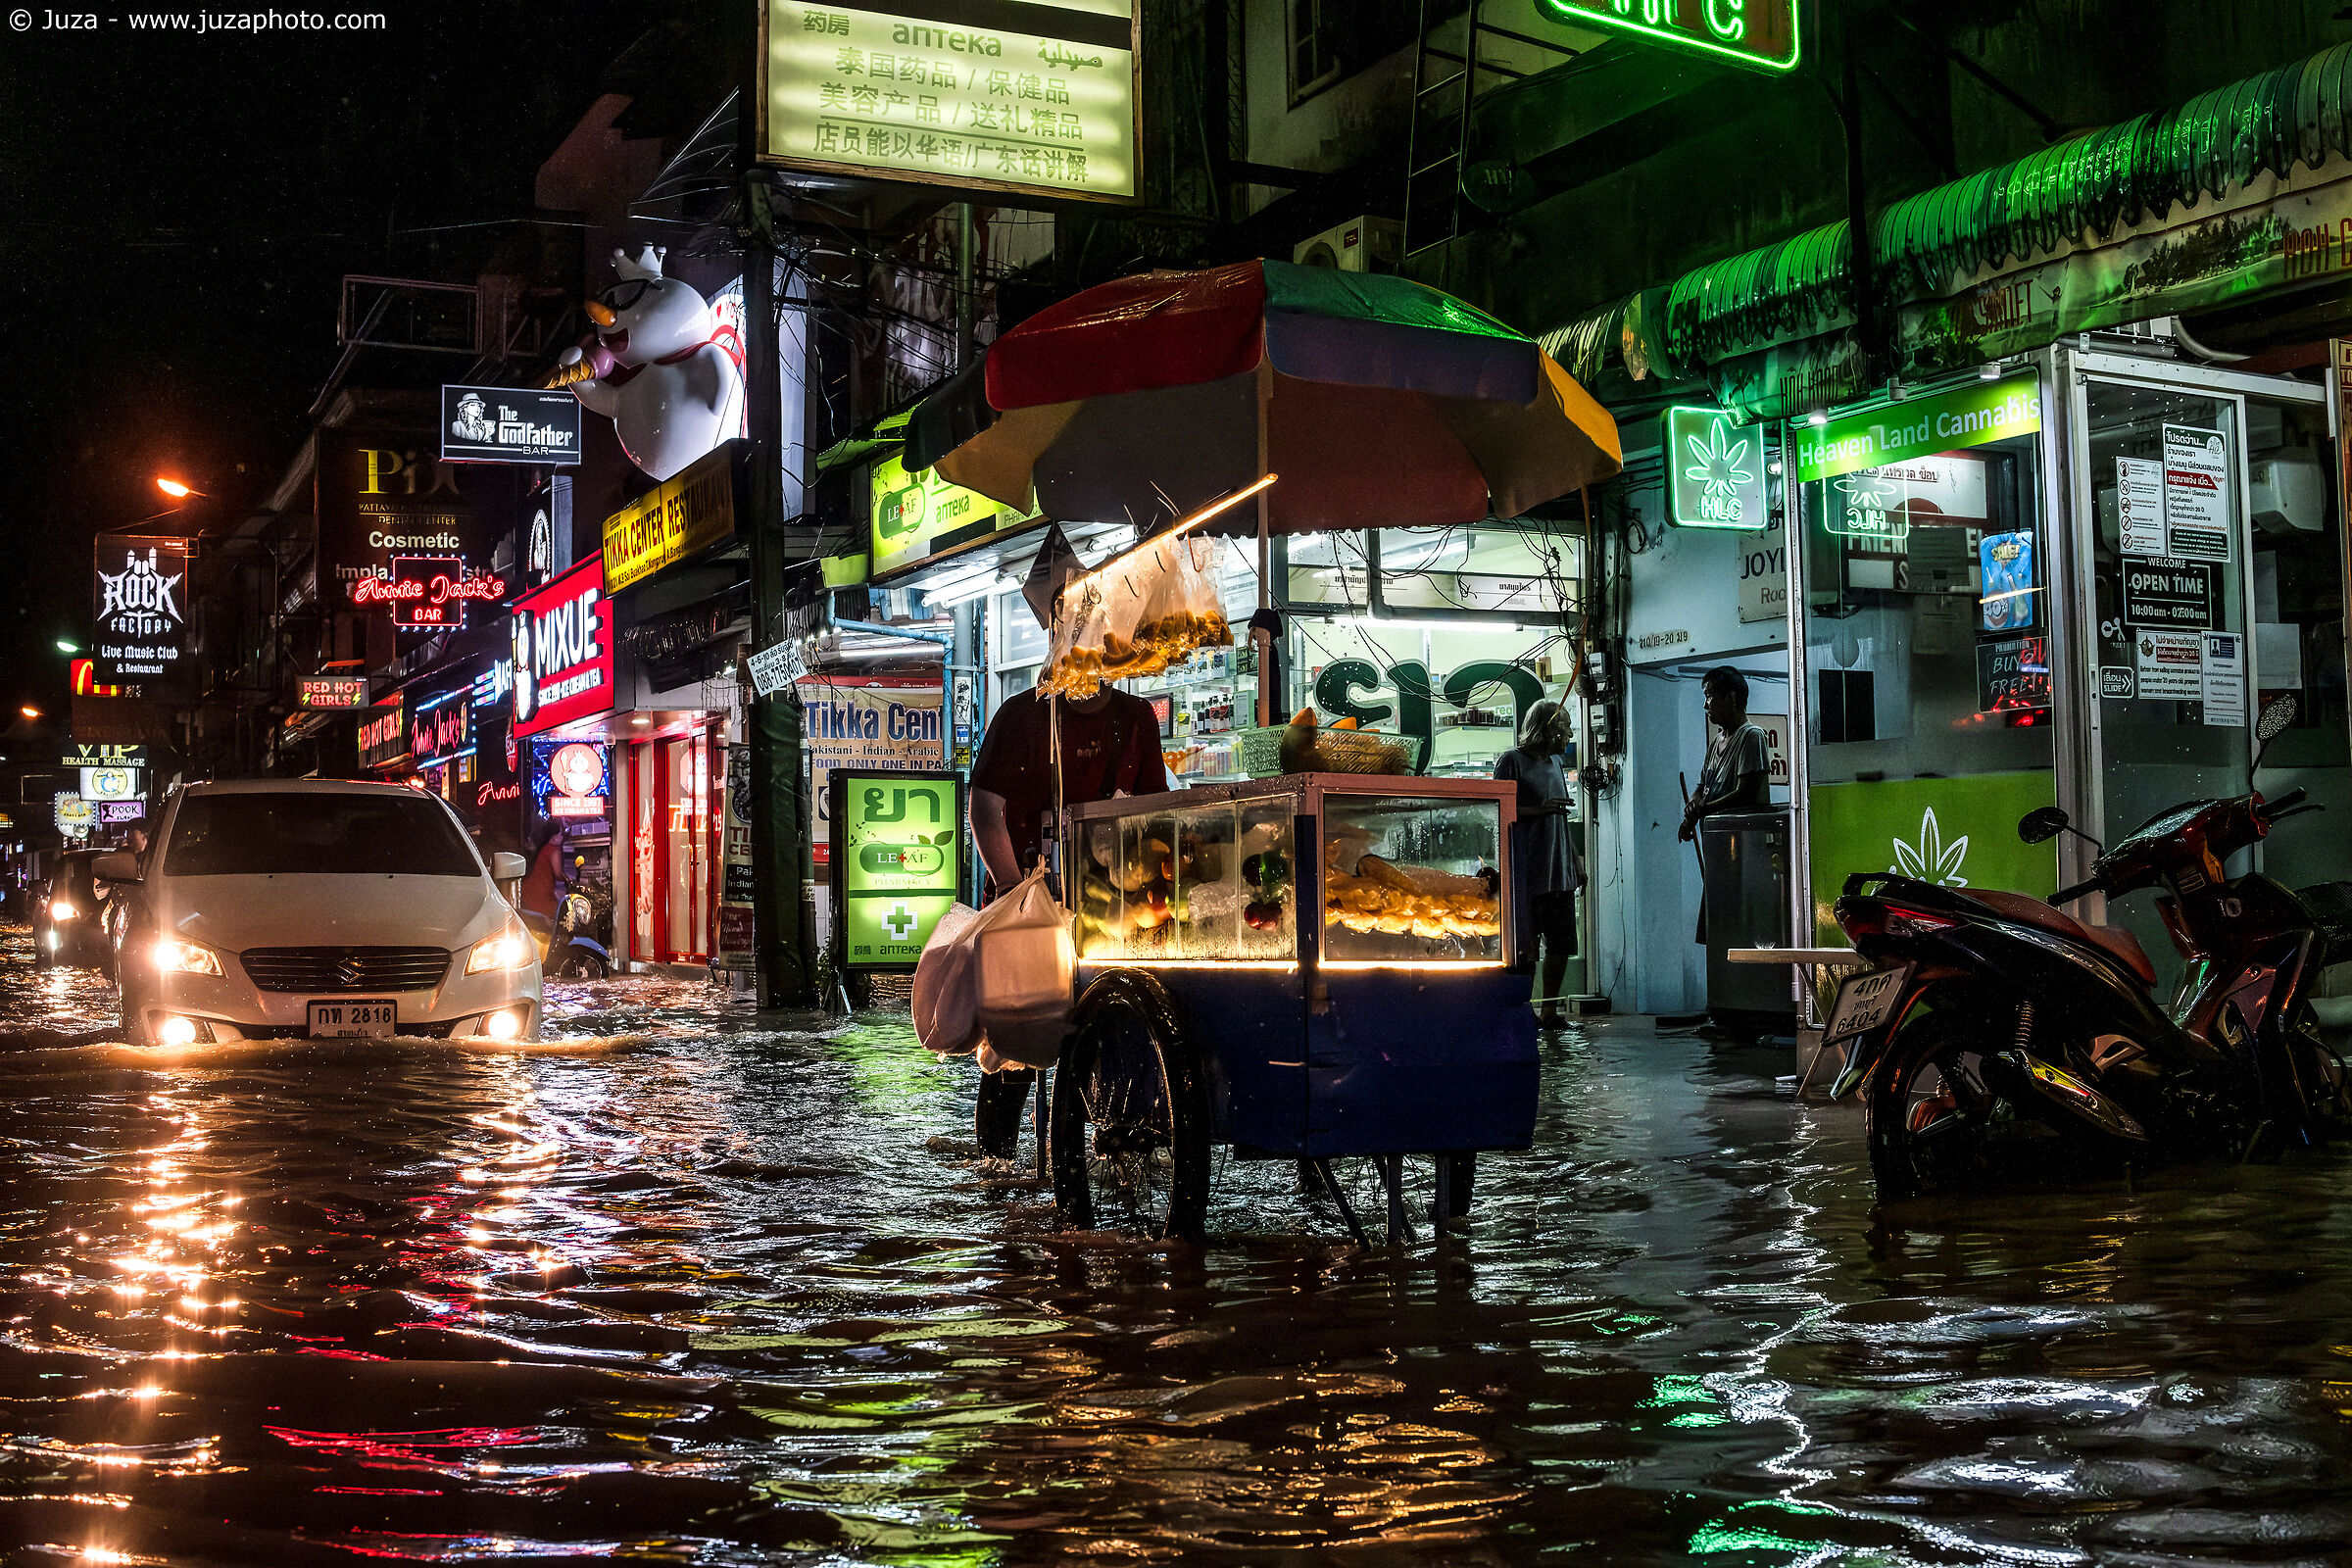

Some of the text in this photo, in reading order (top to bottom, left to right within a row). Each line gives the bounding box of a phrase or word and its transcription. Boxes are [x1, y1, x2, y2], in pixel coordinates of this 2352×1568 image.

[804, 10, 850, 36] 药房
[892, 24, 1003, 57] аптека
[835, 46, 956, 90] 泰国药品
[985, 69, 1070, 105] 保健品
[819, 82, 941, 123] 美容产品
[970, 101, 1083, 139] 送礼精品
[498, 405, 518, 421] The
[498, 421, 573, 447] Godfather
[1799, 394, 2040, 468] Heaven Land Cannabis
[522, 446, 550, 455] BAR
[936, 494, 970, 523] аптека
[1700, 496, 1742, 521] HLC
[368, 531, 461, 549] Cosmetic
[605, 506, 664, 572] TIKKA CENTER
[2147, 557, 2186, 569] WELCOME
[355, 575, 506, 604] Annie Jack's
[2131, 573, 2205, 594] OPEN TIME
[97, 568, 184, 624] ROCK
[111, 610, 172, 639] FACTORY
[413, 608, 442, 620] BAR
[535, 587, 598, 680] MIXUE
[101, 645, 178, 660] Live Music Club
[116, 662, 164, 674] & Restaurant
[1992, 655, 2020, 674] BUY
[304, 681, 363, 693] RED HOT
[2103, 684, 2122, 694] SLIDE
[311, 695, 353, 707] GIRLS
[360, 710, 400, 752] RED HOT GIRLS
[805, 701, 879, 740] Tikka
[63, 757, 145, 766] HEALTH MASSAGE
[863, 745, 895, 756] Indian
[906, 746, 939, 757] Arabic
[882, 760, 906, 769] ONE
[910, 760, 922, 769] IN
[864, 788, 941, 823] ยา
[879, 945, 921, 955] аптека
